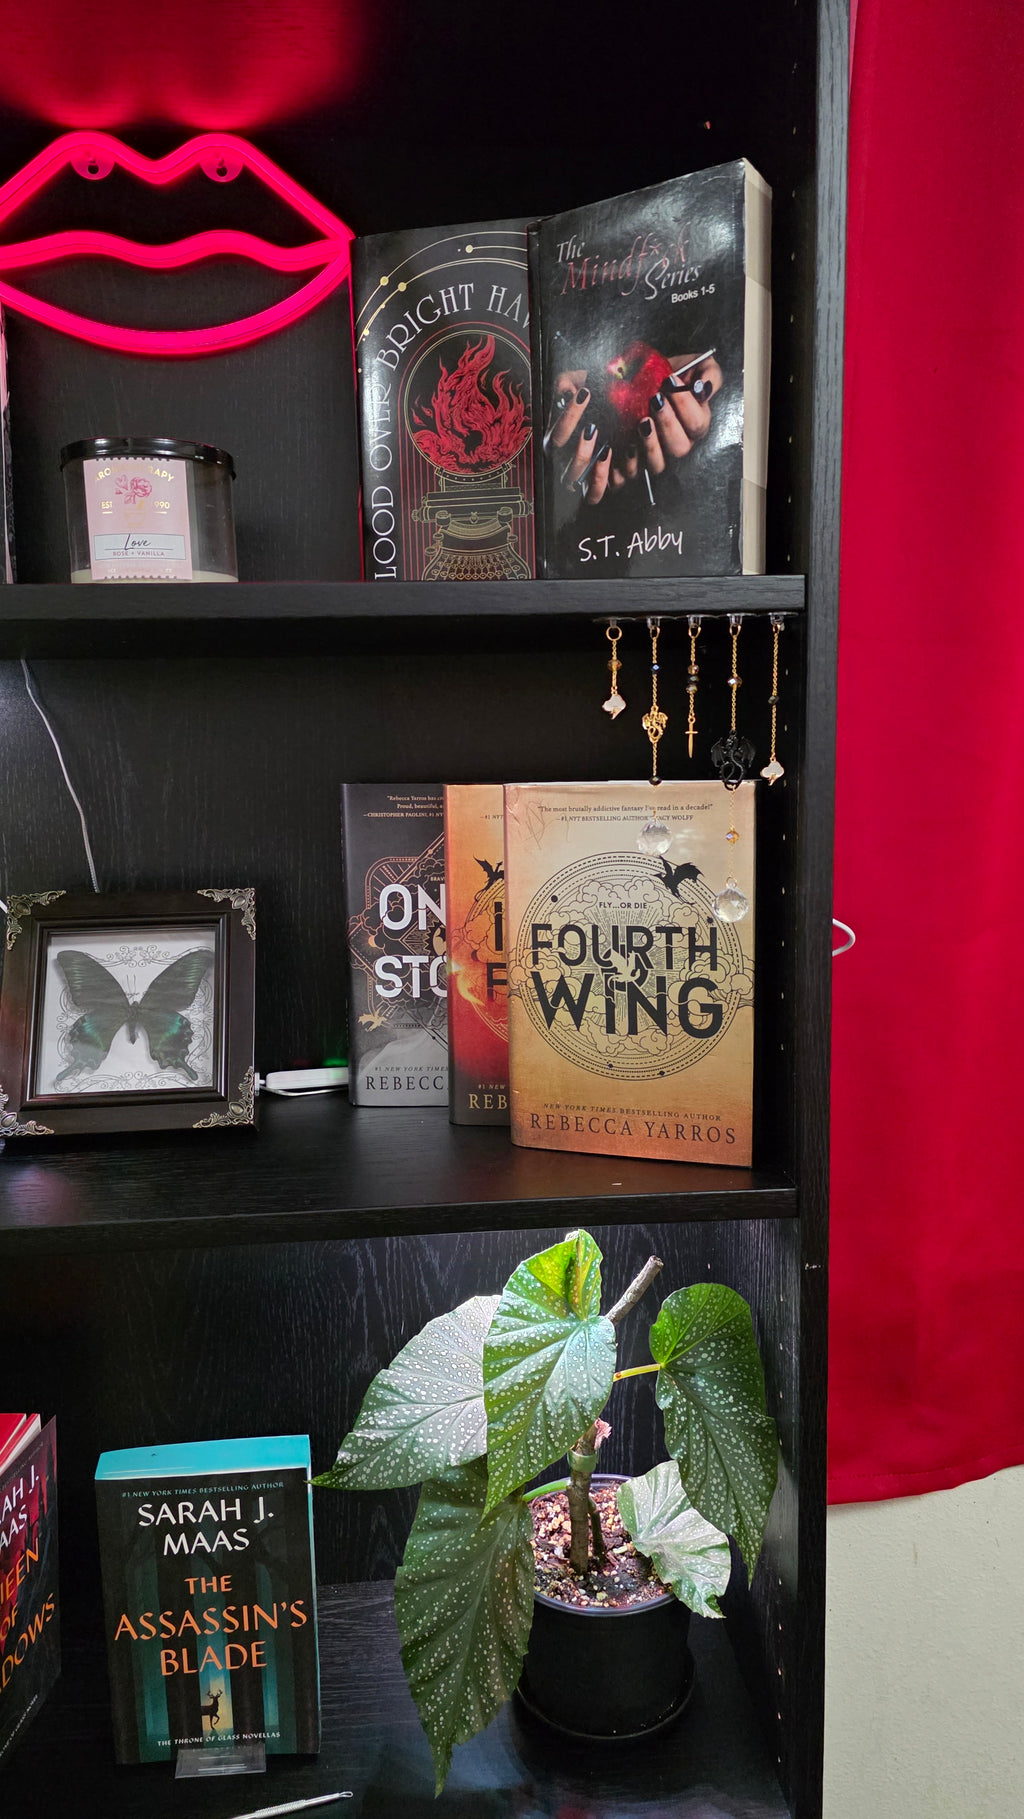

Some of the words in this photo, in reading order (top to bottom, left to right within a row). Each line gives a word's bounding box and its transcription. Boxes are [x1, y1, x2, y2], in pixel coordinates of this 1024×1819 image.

[557, 234, 585, 263] The
[644, 257, 702, 300] Series
[671, 289, 699, 303] Books
[700, 284, 716, 297] 1-5
[376, 282, 475, 372] BRIGHT
[369, 383, 393, 472] OVER
[154, 501, 171, 510] 990
[124, 533, 151, 551] Love
[578, 535, 620, 562] S.T.
[627, 526, 683, 558] Abby
[569, 805, 591, 813] brutally
[593, 804, 620, 812] addictive
[621, 804, 643, 812] fantasy
[634, 901, 648, 910] DIE
[531, 923, 718, 972] FOURTH
[530, 970, 724, 1040] WING
[366, 1076, 448, 1091] REBECC
[530, 1113, 633, 1136] REBECCA
[645, 1121, 736, 1144] YARROS
[590, 1106, 616, 1114] TIMES
[619, 1108, 680, 1118] BESTSELLING
[684, 1113, 721, 1121] AUTHOR
[0, 1477, 24, 1525] AH
[29, 1464, 40, 1494] J.
[199, 1485, 249, 1494] BESTSELLING
[251, 1481, 284, 1490] AUTHOR
[138, 1498, 241, 1527] SARAH
[253, 1496, 274, 1524] J.
[163, 1528, 250, 1556] MAAS
[184, 1575, 233, 1595] THE
[0, 1602, 19, 1641] OF
[114, 1600, 308, 1641] ASSASSIN'S
[0, 1592, 55, 1694] DOWS
[160, 1640, 268, 1676] BLADE
[174, 1737, 204, 1745] THRONE
[217, 1734, 240, 1742] GLASS
